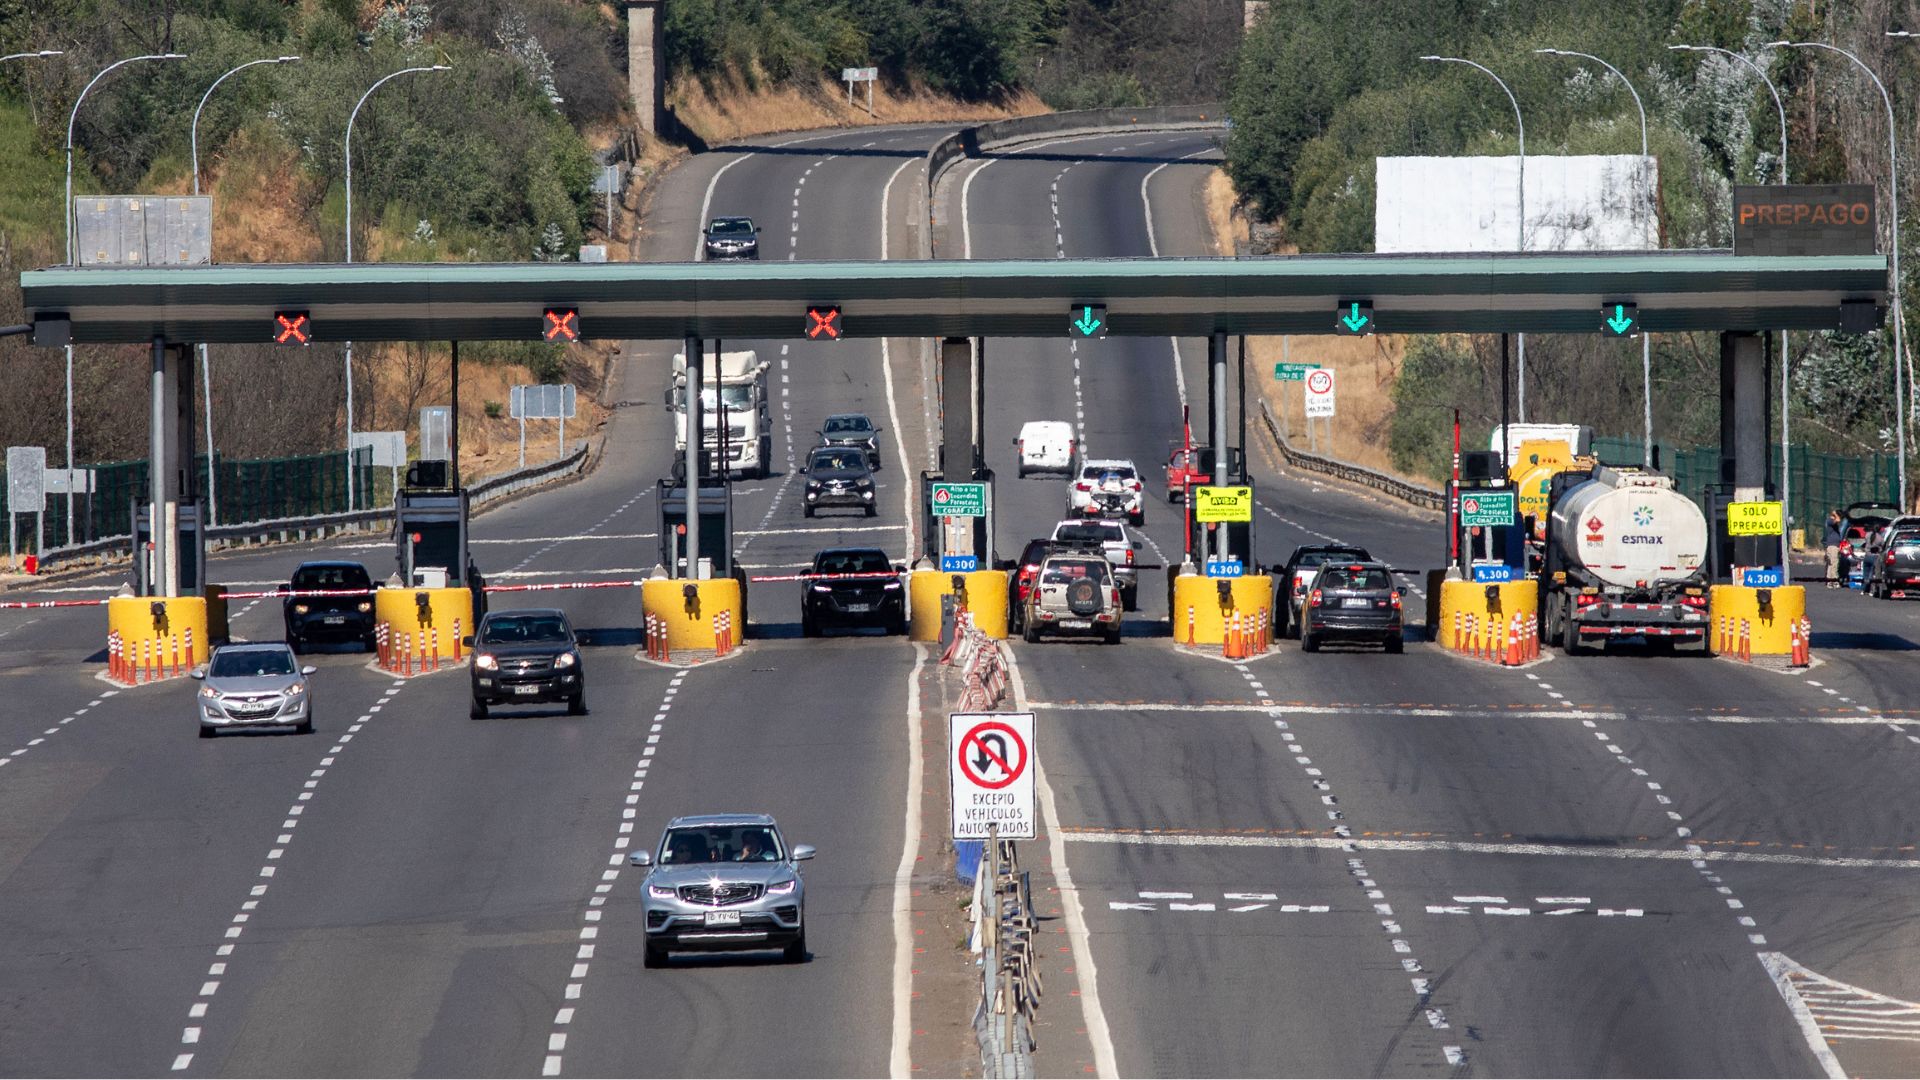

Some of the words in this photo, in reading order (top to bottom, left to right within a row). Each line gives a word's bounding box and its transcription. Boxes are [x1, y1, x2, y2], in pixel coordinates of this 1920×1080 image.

[1740, 203, 1870, 225] PREPAGO
[1743, 507, 1768, 516] SOLO
[1733, 521, 1778, 530] PREPAGO
[1622, 534, 1663, 544] esmax
[945, 560, 975, 569] 4.300
[1210, 564, 1240, 574] 4.300
[1478, 570, 1509, 580] 4.300
[1747, 574, 1777, 583] 4.300
[973, 793, 1014, 805] EXCEPTO
[965, 808, 1023, 820] VEHICULOS
[959, 822, 1029, 834] AUTORZADOS
